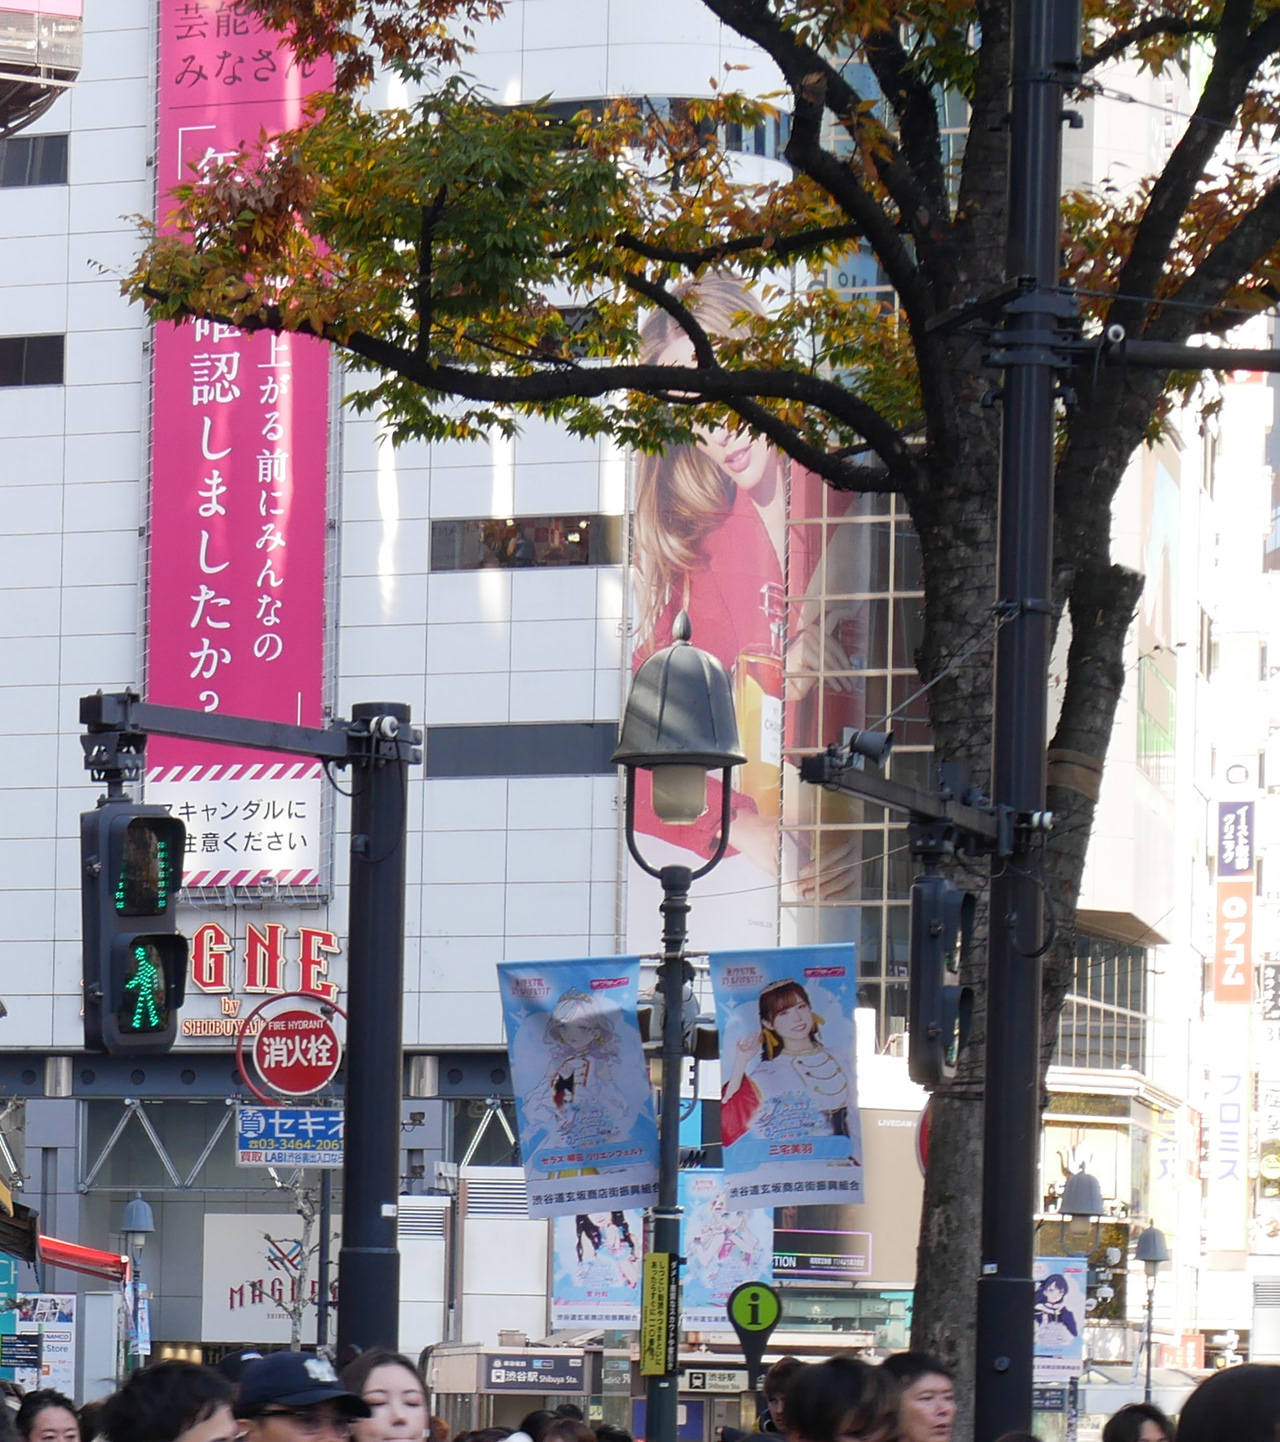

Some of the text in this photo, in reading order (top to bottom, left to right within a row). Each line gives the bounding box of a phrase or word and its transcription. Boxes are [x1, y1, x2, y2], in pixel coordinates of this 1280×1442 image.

[221, 997, 240, 1017] by
[268, 1019, 324, 1031] FIRE HYDRANT
[262, 1034, 333, 1068] 消火栓
[240, 1110, 264, 1138] 質
[241, 1150, 263, 1163] 買取
[729, 1180, 860, 1199] 渋谷道玄坂商店街振興組合
[47, 1344, 69, 1353] Store
[505, 1371, 539, 1383] 渋谷駅
[539, 1375, 579, 1385] Shibuya Sta.
[708, 1372, 737, 1382] 渋谷駅
